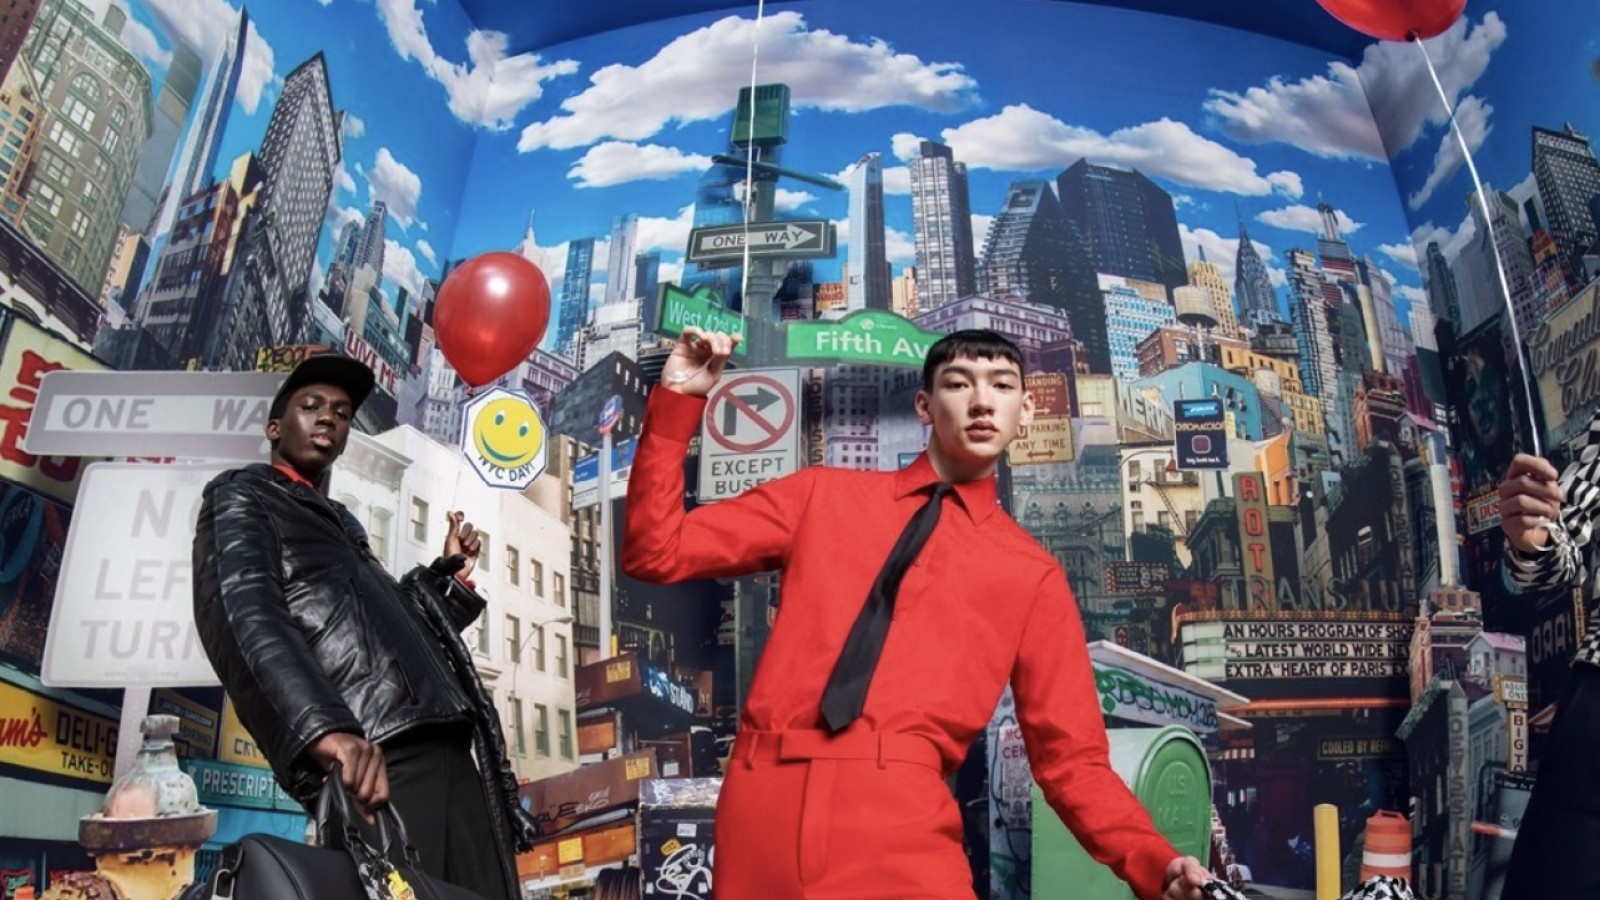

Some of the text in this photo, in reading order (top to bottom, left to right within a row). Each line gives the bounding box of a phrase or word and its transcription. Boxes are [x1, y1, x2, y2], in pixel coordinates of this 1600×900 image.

[712, 230, 803, 248] ONE WAY
[670, 299, 702, 327] West
[816, 331, 882, 355] Fifth
[62, 398, 155, 430] ONE
[1031, 423, 1066, 433] PARKING
[1015, 439, 1067, 451] ANY TIME
[711, 457, 785, 477] EXCEPT
[715, 478, 779, 496] BUS
[94, 558, 192, 601] LEF
[1223, 624, 1245, 638] AN
[1250, 624, 1295, 638] HOURS
[1299, 624, 1366, 638] PROGRAM
[1368, 624, 1382, 638] OF
[1245, 643, 1301, 658] LATEST
[1302, 643, 1349, 658] WORLD
[1352, 643, 1384, 658] WIDE
[1226, 662, 1274, 678] EXTRA
[1331, 661, 1347, 677] OF
[202, 768, 290, 800] PRESCRIPTI
